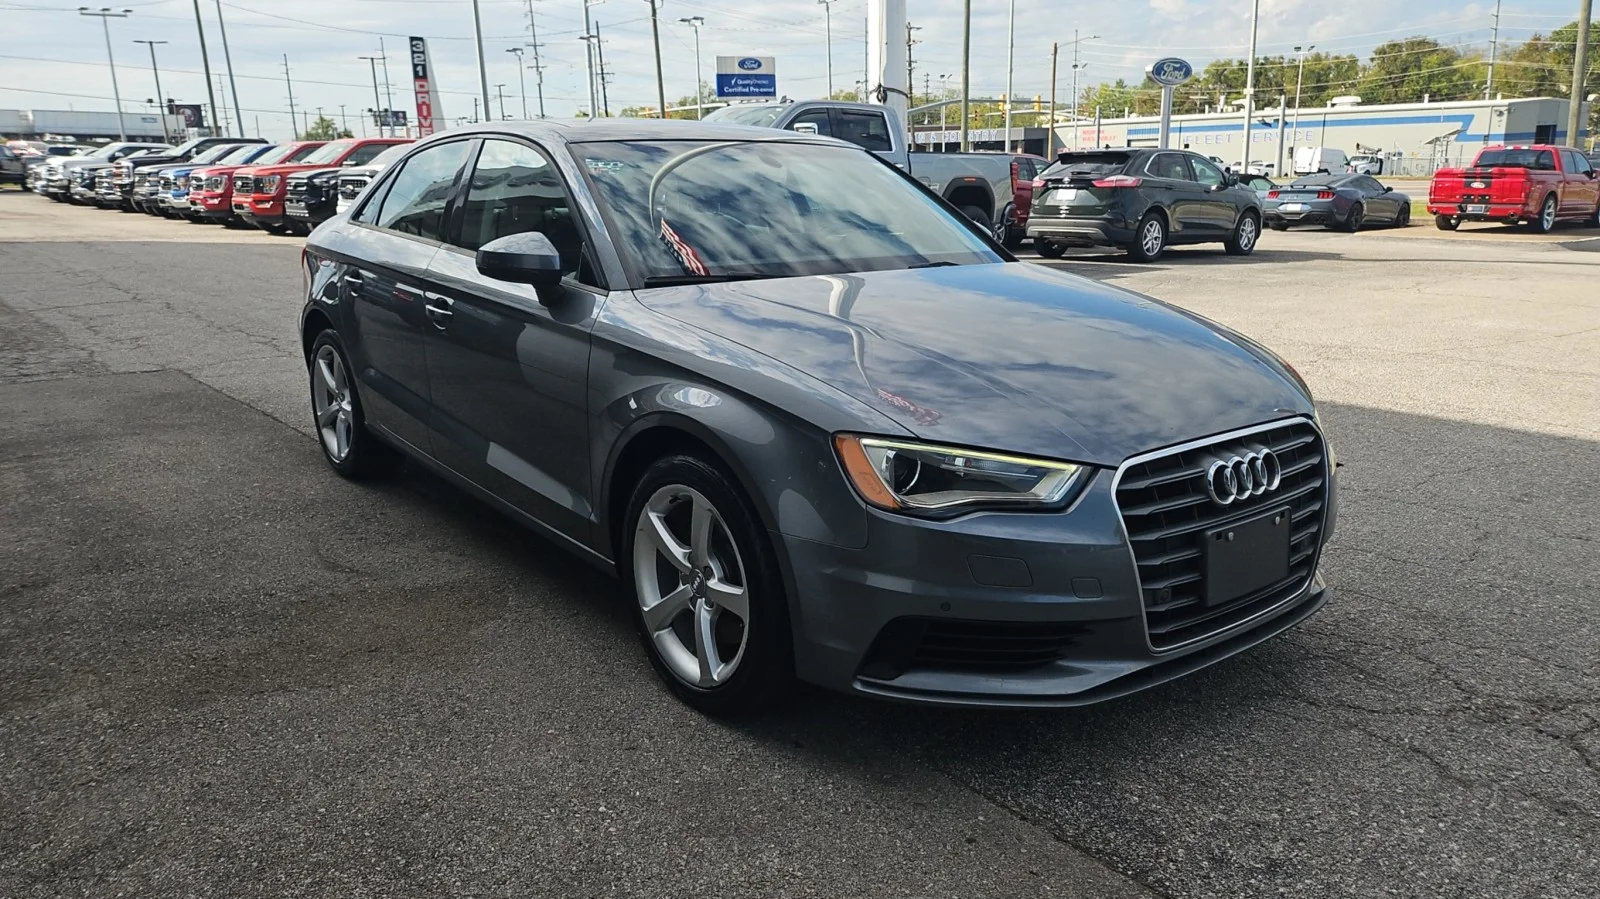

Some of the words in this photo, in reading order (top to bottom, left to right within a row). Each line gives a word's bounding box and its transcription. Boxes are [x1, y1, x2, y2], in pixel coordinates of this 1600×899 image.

[411, 40, 426, 76] 321
[415, 80, 433, 139] DRIVE
[1184, 133, 1232, 145] FLEET
[1242, 130, 1313, 144] ERICE
